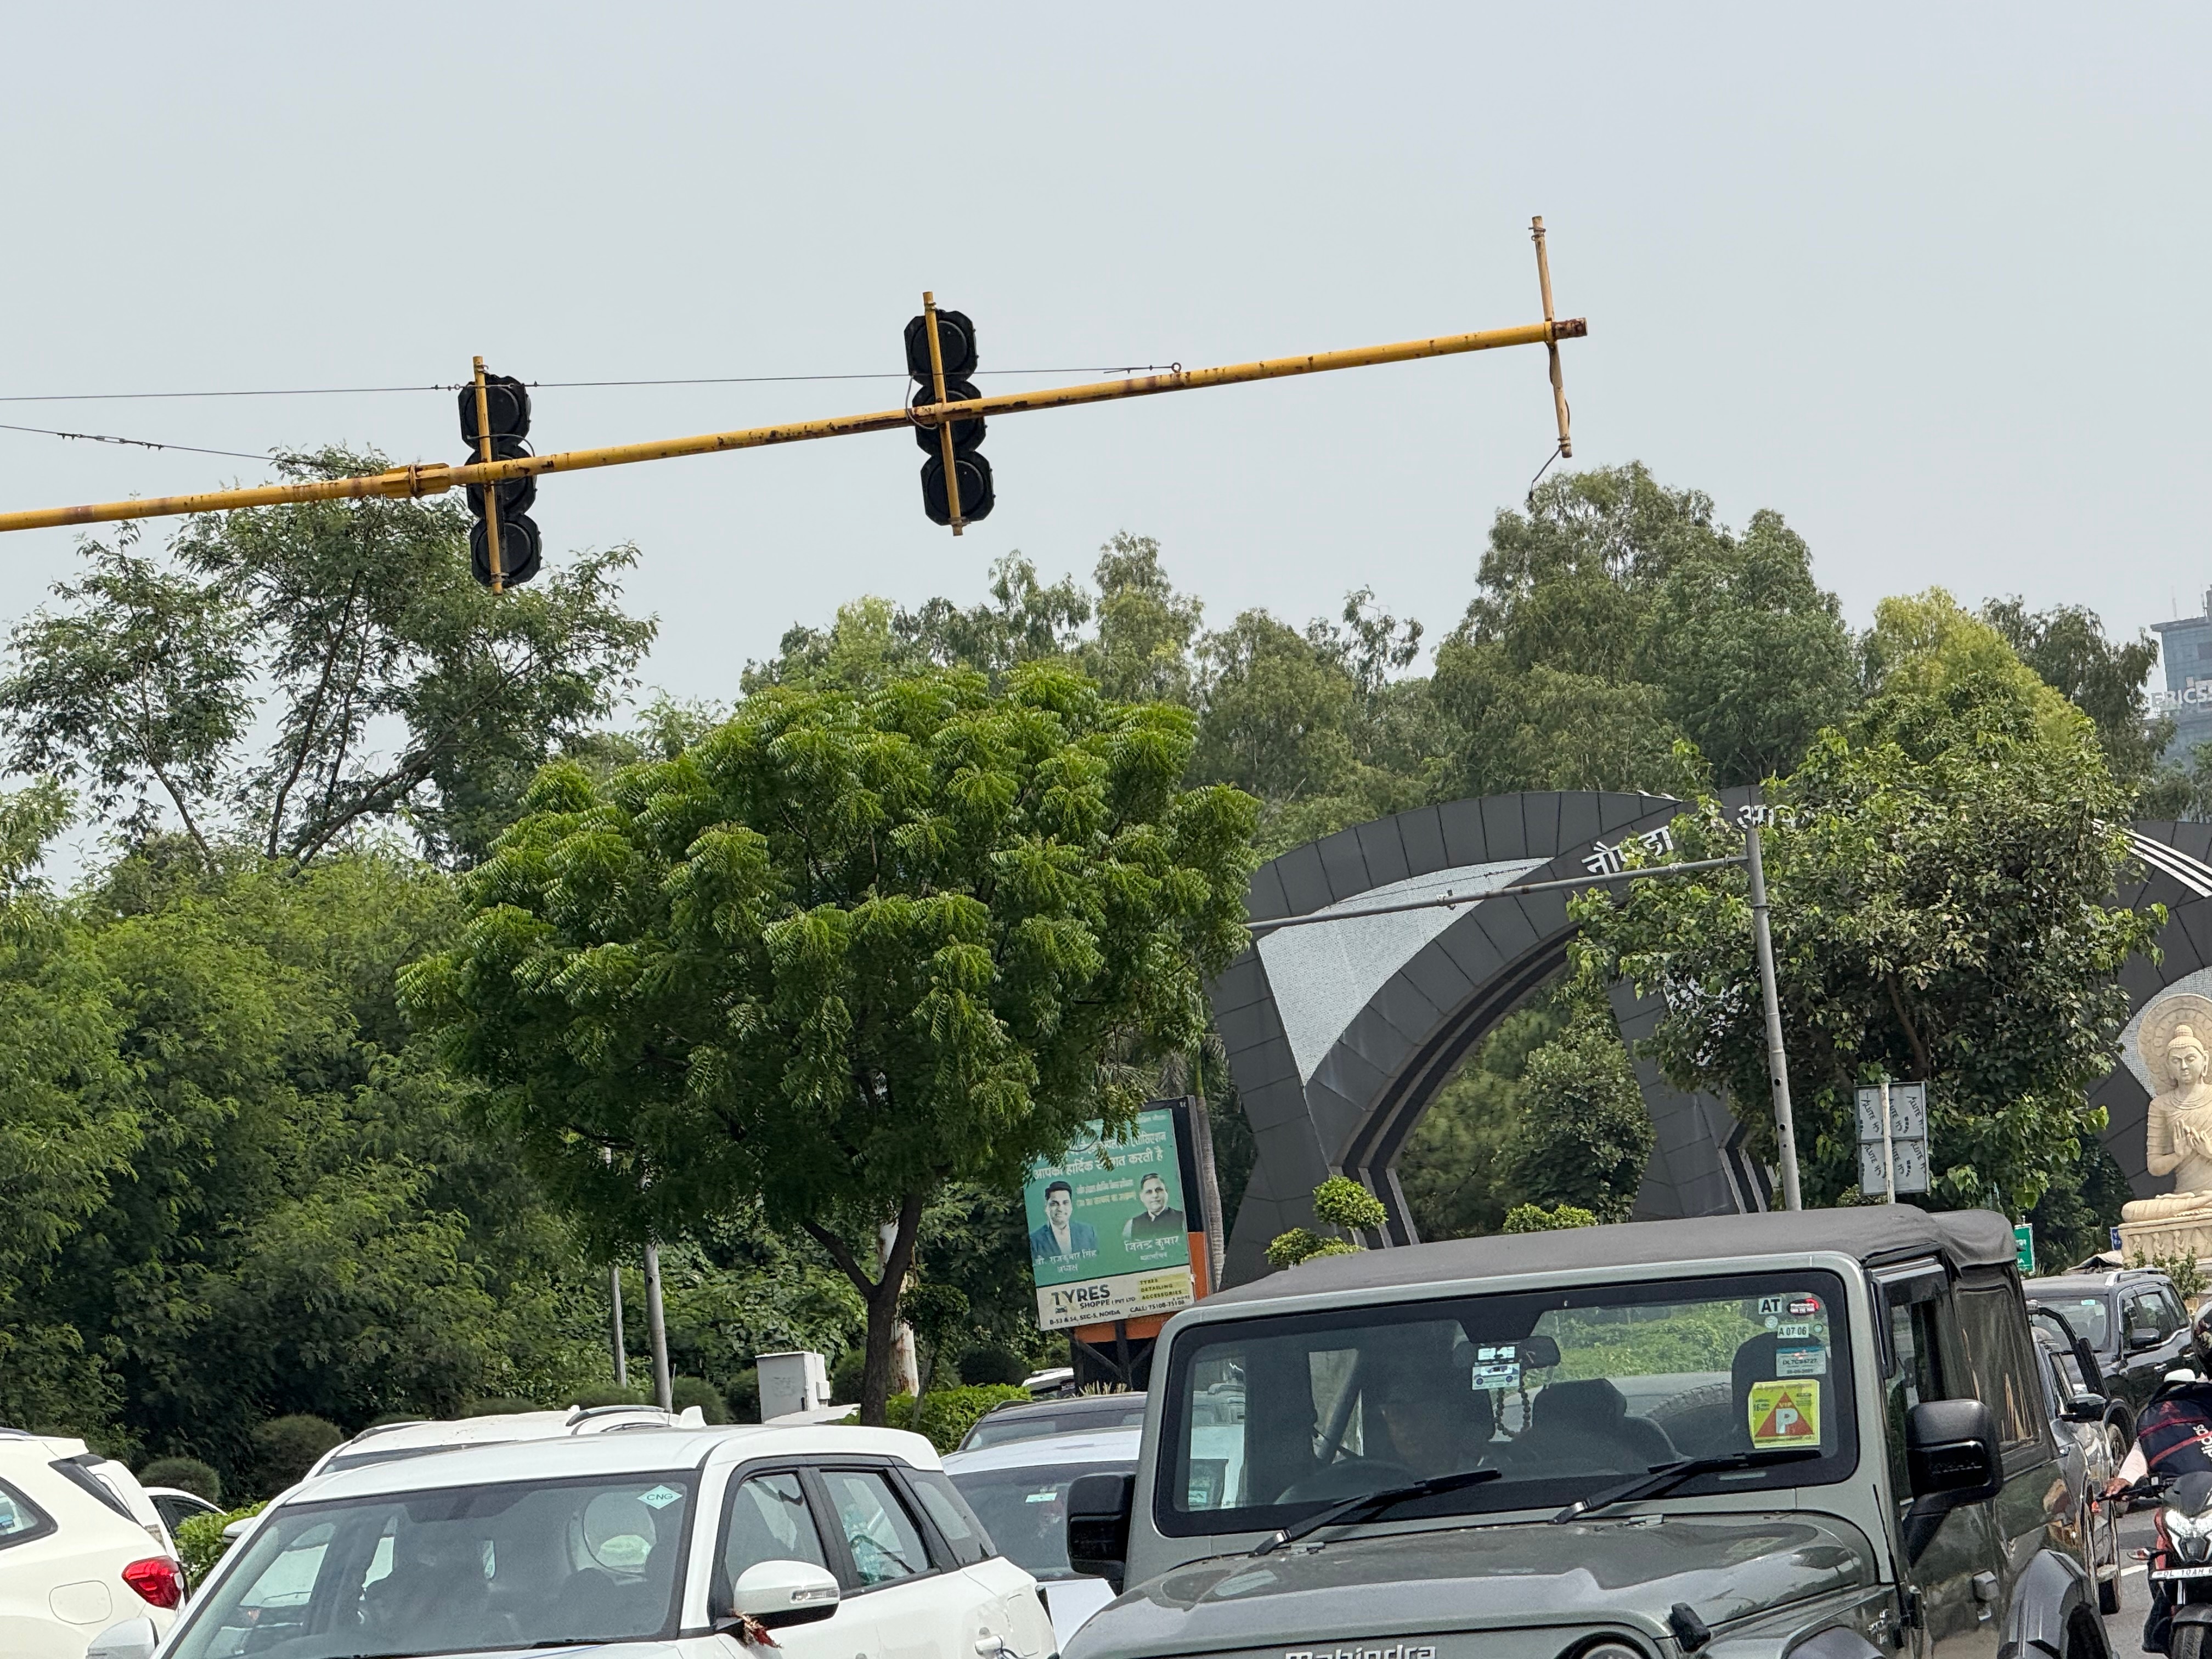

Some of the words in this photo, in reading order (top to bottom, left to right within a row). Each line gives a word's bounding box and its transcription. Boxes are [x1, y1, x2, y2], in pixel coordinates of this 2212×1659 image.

[1051, 1284, 1110, 1306] TYRES
[1080, 1299, 1110, 1309] SHOPPE
[1761, 1299, 1780, 1313] AT
[1776, 1408, 1798, 1434] P
[2192, 1424, 2212, 1462] didas
[647, 1493, 673, 1501] CNG
